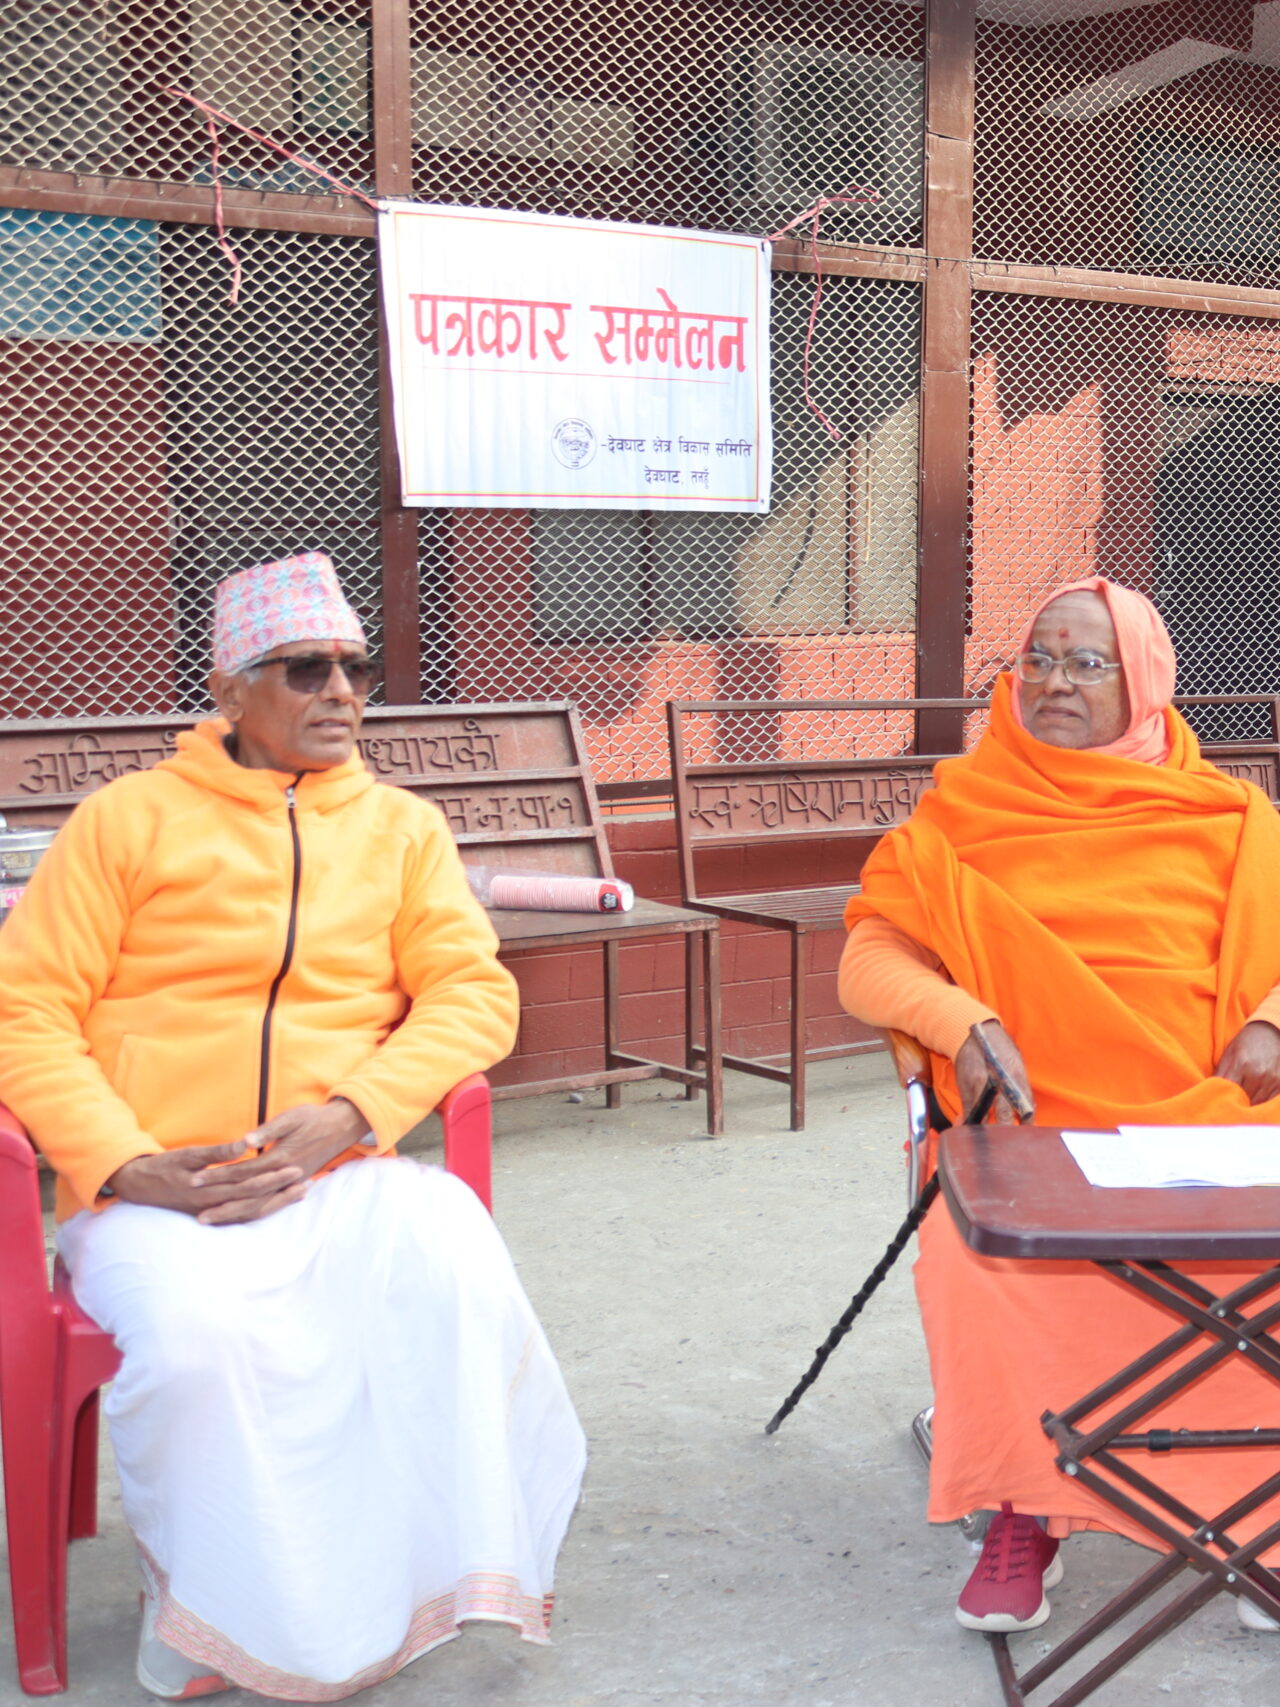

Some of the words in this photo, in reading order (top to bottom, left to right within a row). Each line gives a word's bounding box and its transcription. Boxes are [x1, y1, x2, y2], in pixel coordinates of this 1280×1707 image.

[409, 292, 572, 362] पत्रकार
[589, 287, 749, 373] सम्मेलन
[653, 436, 673, 453] क्षेत्र
[679, 435, 710, 455] विकास
[715, 438, 753, 458] समिति
